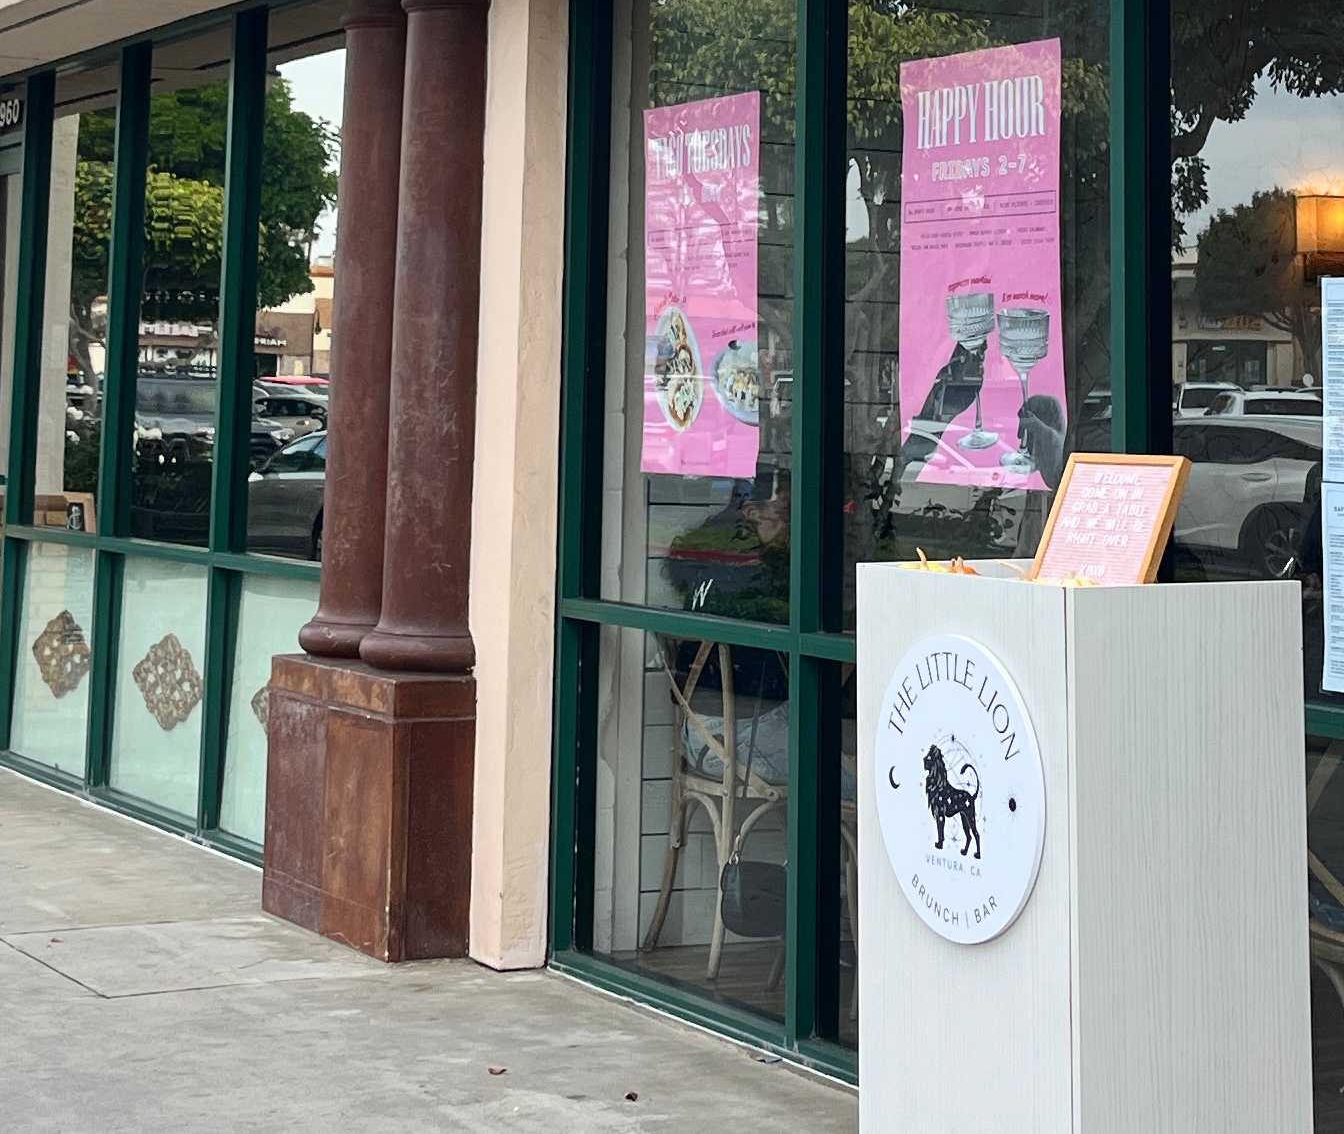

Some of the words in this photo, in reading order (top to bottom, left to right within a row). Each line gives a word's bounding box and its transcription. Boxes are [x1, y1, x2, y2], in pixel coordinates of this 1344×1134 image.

[917, 83, 981, 150] HAPPY
[983, 74, 1045, 142] HOUR
[685, 124, 751, 174] TUESDAYS
[932, 156, 990, 181] FRIDAYS
[998, 153, 1027, 175] 2-7
[1095, 472, 1141, 485] WELCOME
[1082, 486, 1108, 499] COME
[1116, 487, 1128, 500] ON
[1131, 488, 1144, 500] IN
[1071, 501, 1099, 515] GRAB
[1100, 503, 1110, 515] A
[1117, 503, 1146, 516] TABLE
[1061, 516, 1081, 529] AND
[1086, 518, 1100, 530] WE
[1105, 518, 1127, 531] WILL
[1133, 519, 1145, 532] BE
[1066, 531, 1096, 545] RIGHT
[1103, 534, 1129, 546] OVER
[888, 676, 918, 735] THE
[916, 651, 975, 691] LITTLE
[978, 676, 1020, 760] LION
[971, 866, 981, 878] CA
[912, 874, 959, 926] BRUNCH
[974, 896, 997, 923] BAR
